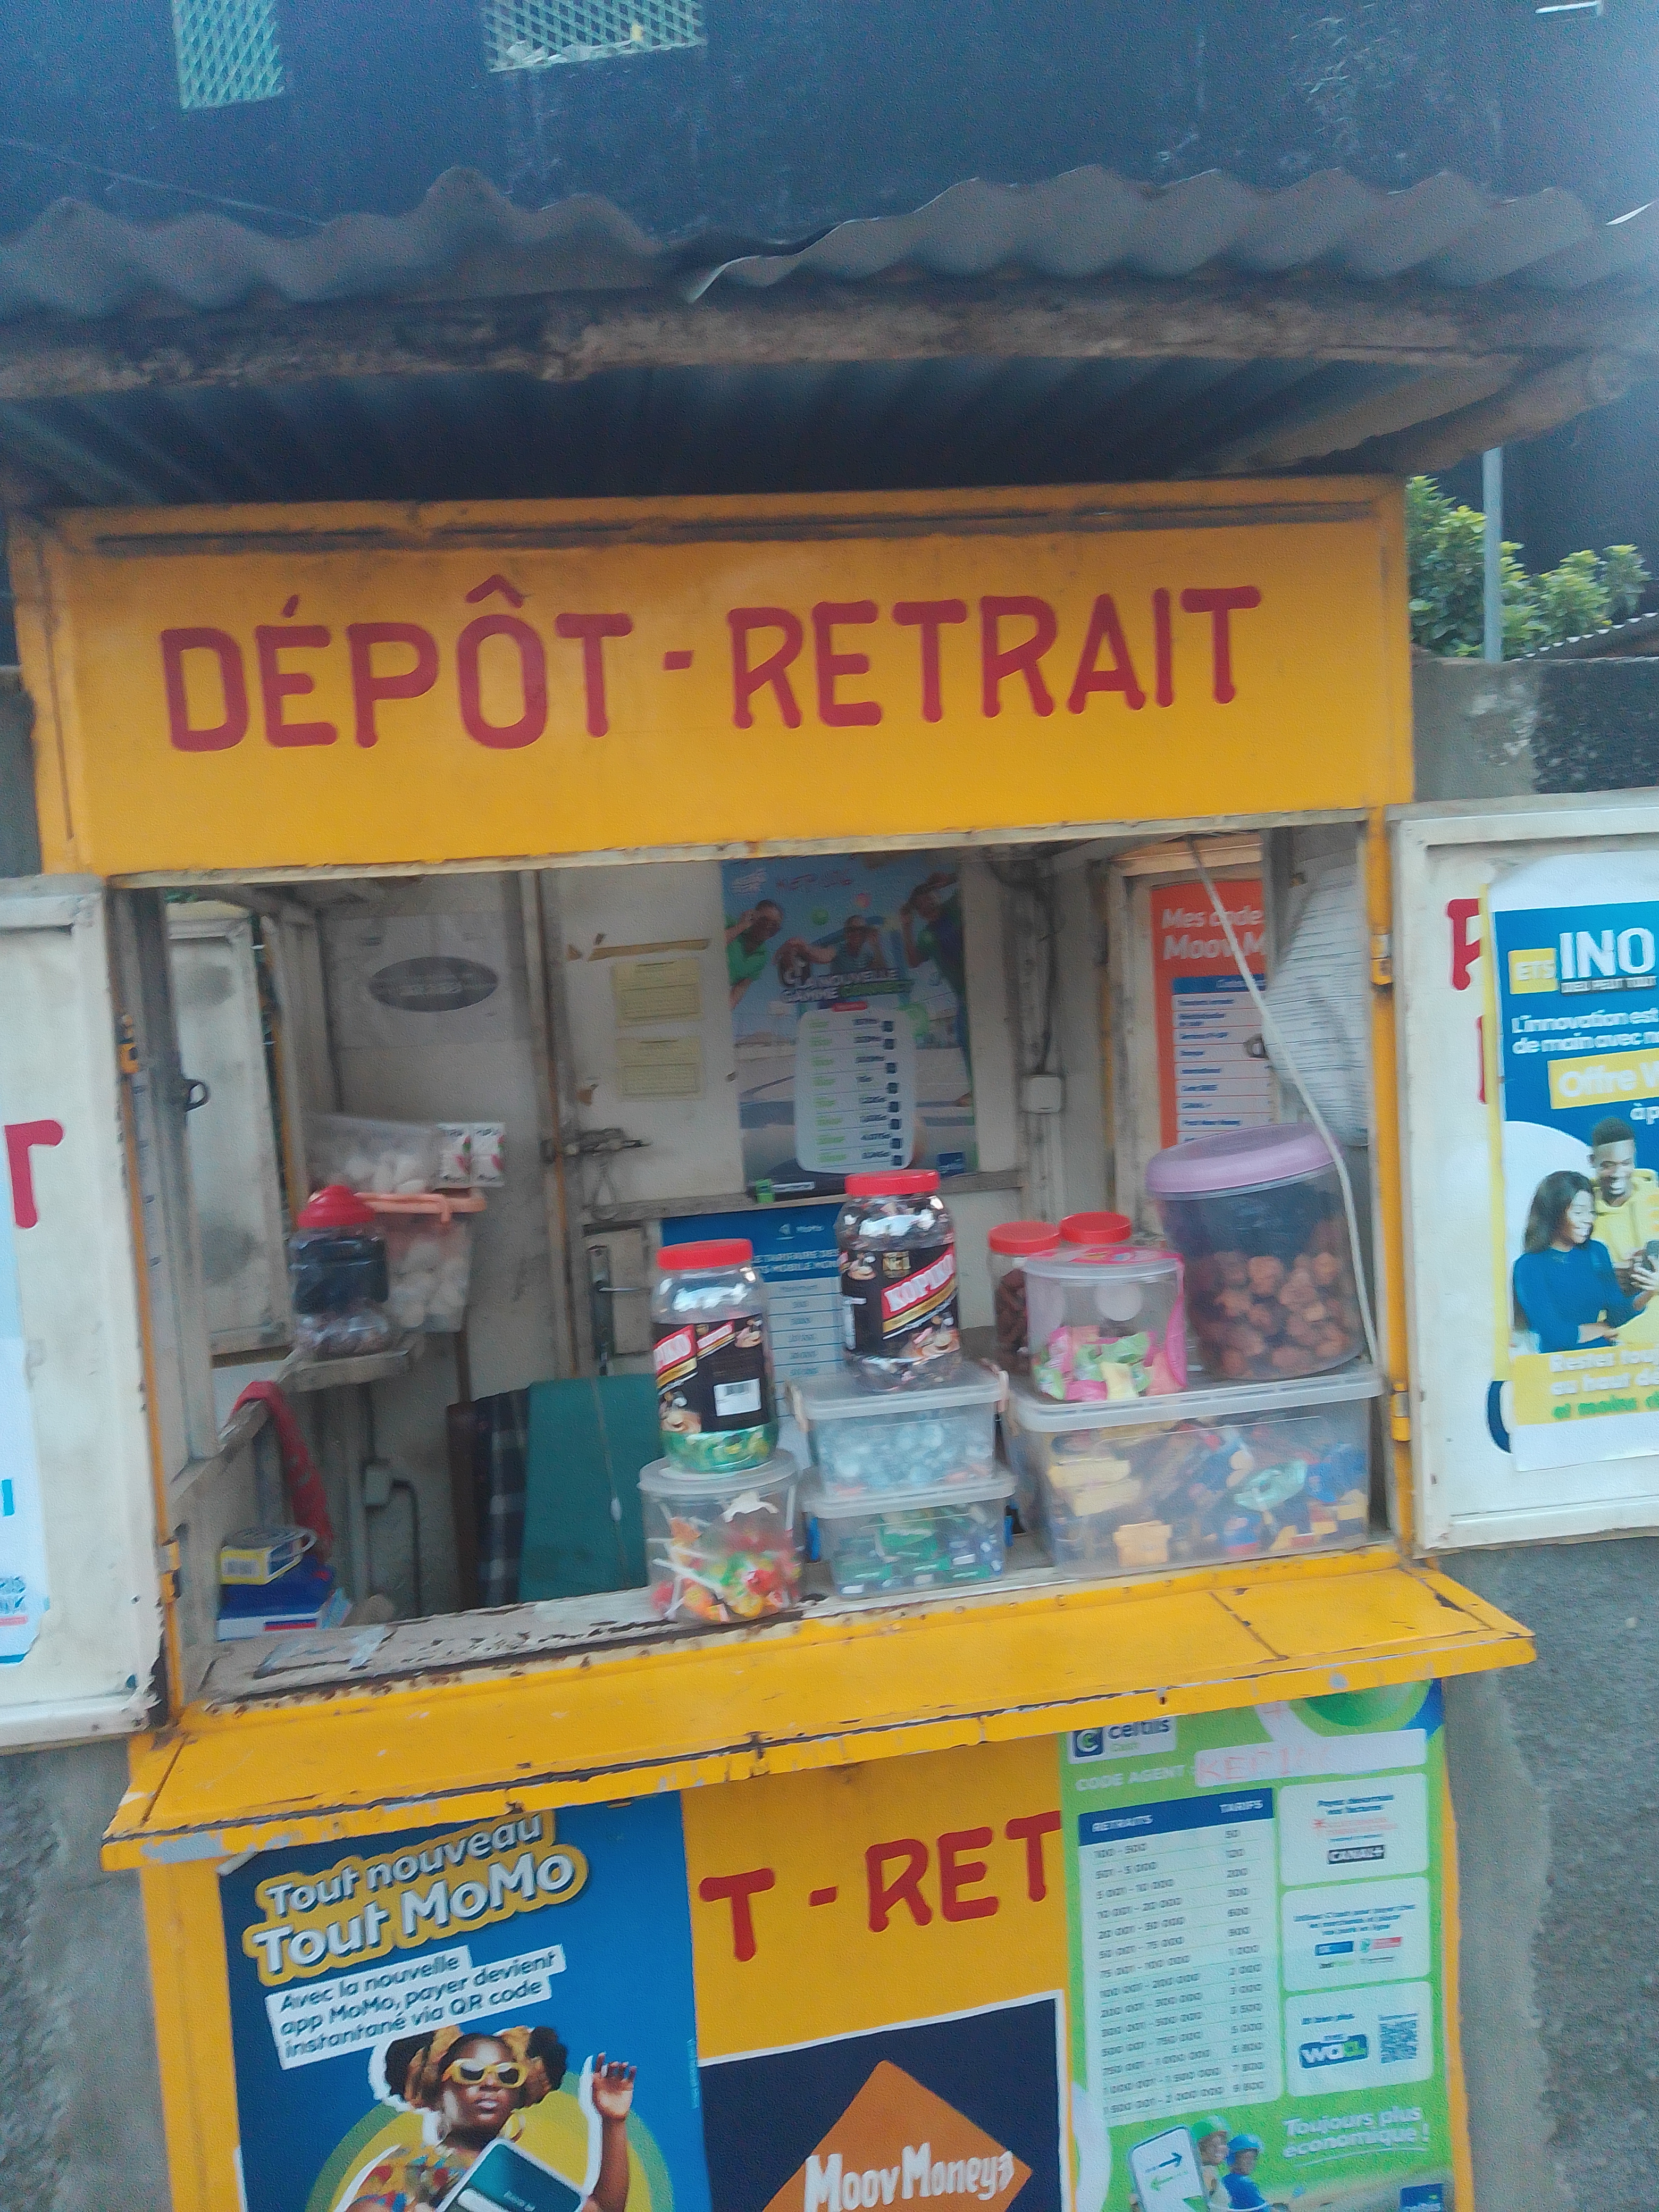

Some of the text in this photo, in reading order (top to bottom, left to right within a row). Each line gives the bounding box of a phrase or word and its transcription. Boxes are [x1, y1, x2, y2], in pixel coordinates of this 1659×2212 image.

[159, 574, 633, 753] DÉPÔT
[726, 585, 1263, 731] RETRAIT
[1162, 908, 1205, 929] Mes
[1558, 1065, 1637, 1098] Offre
[1075, 1773, 1124, 1791] CODE
[1127, 1764, 1185, 1784] AGENT
[265, 1813, 542, 1916] Tout nouveau
[865, 1809, 1062, 1933] RET
[252, 1851, 576, 1974] Tout MoMo
[280, 1953, 461, 2014] Avec la nouvelle
[280, 2012, 324, 2038] app
[404, 1975, 471, 2012] payer
[473, 1950, 557, 1989] devient
[283, 1979, 543, 2059] instantané via QR code
[1281, 2113, 1373, 2136] Toujours
